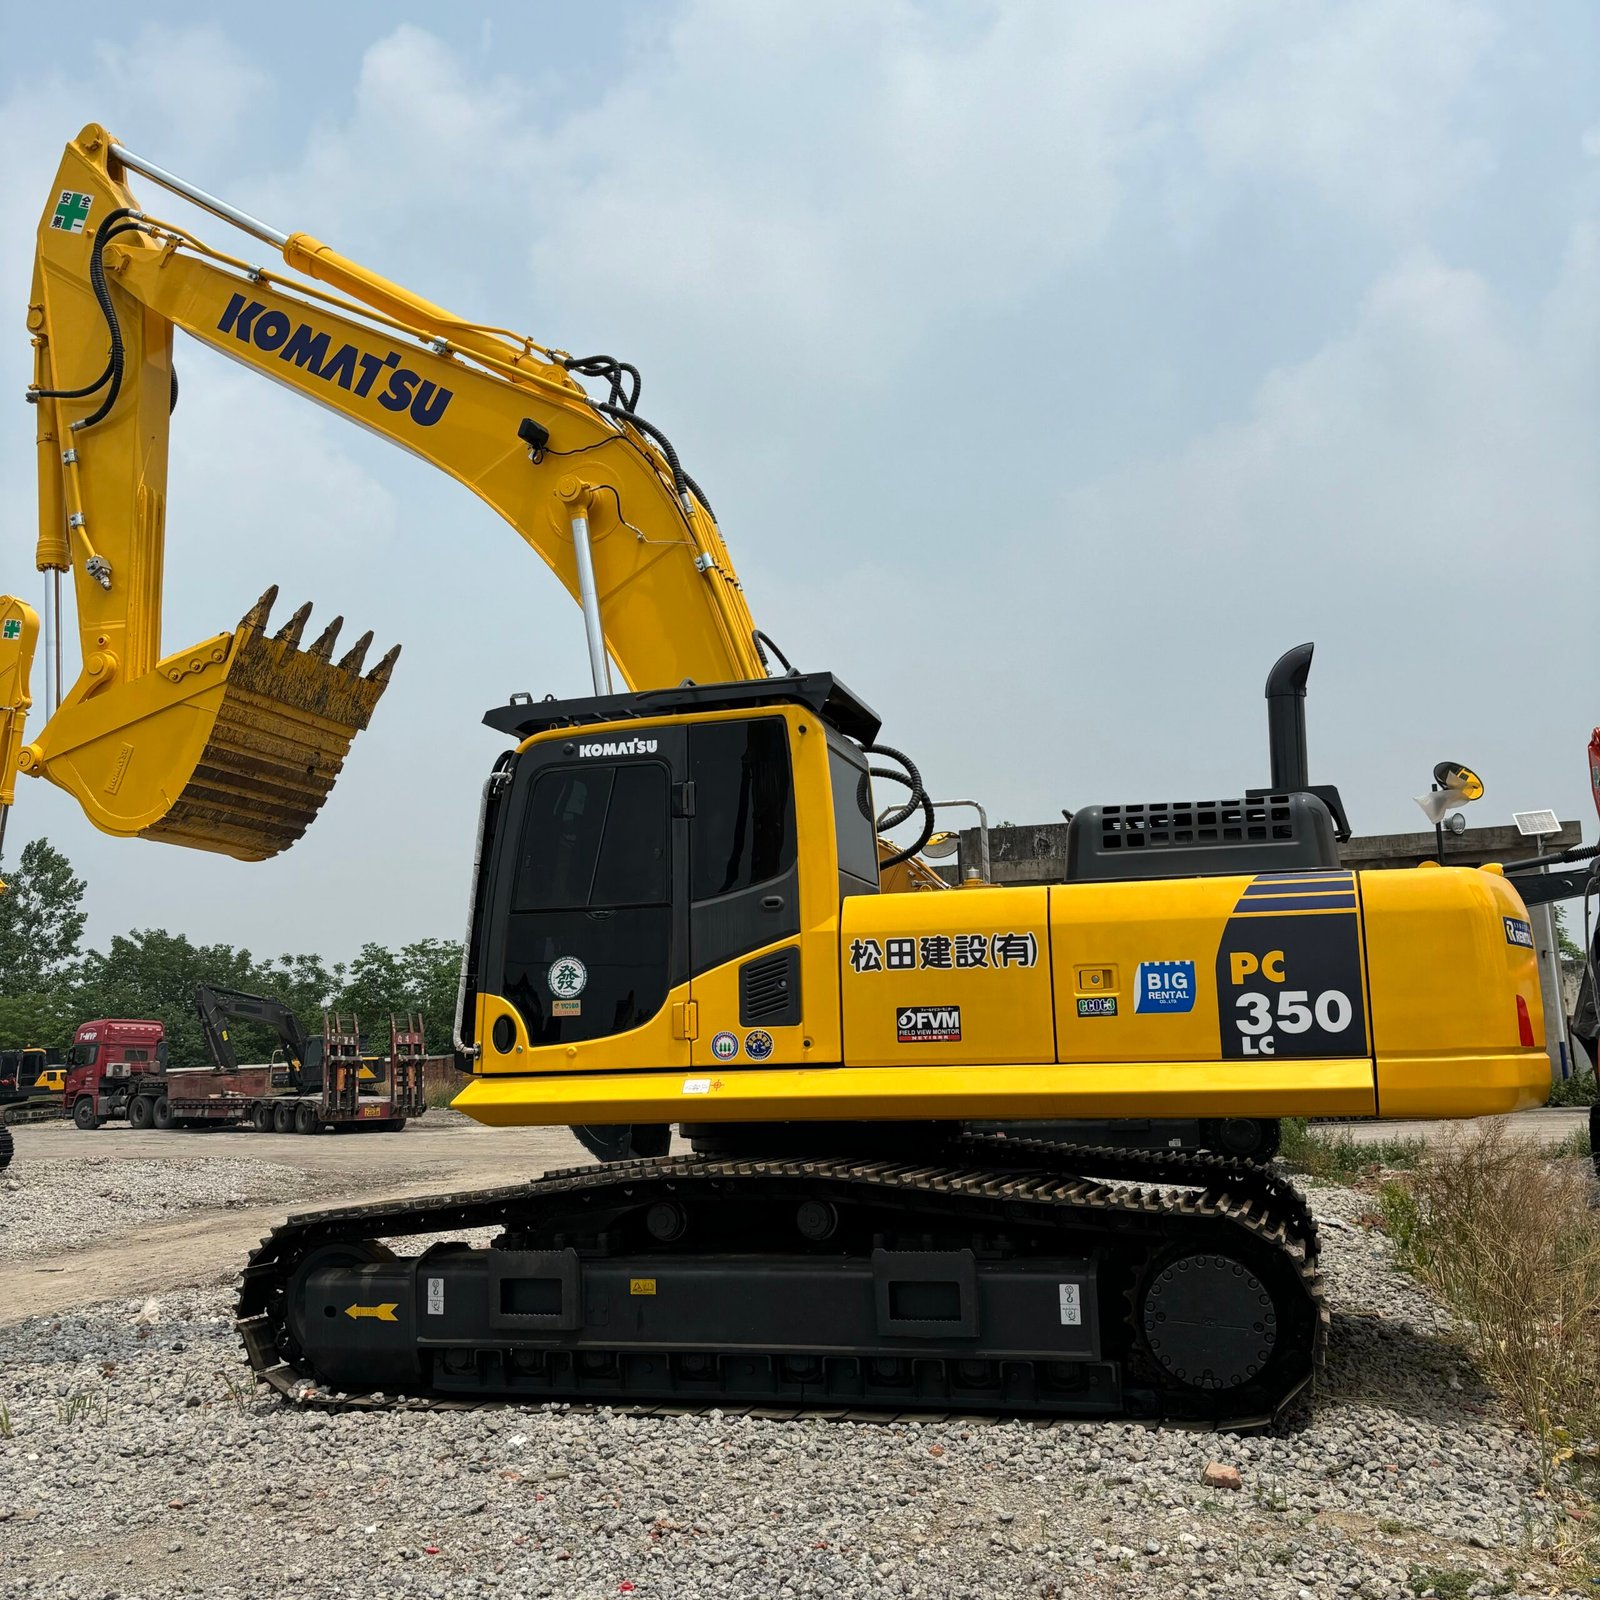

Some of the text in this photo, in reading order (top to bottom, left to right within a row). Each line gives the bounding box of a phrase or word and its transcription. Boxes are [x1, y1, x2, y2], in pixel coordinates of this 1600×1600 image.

[217, 292, 454, 427] KOMATSU
[579, 738, 658, 757] KOMATSU
[850, 932, 1037, 972] 松田建設(有)
[555, 964, 581, 990] 發
[1230, 950, 1285, 985] PC
[1147, 972, 1188, 989] BIG
[1079, 998, 1116, 1012] ecot3
[1148, 991, 1189, 999] RENTAL
[916, 1011, 960, 1028] FVM
[1236, 990, 1352, 1035] 350
[1242, 1035, 1275, 1055] LC
